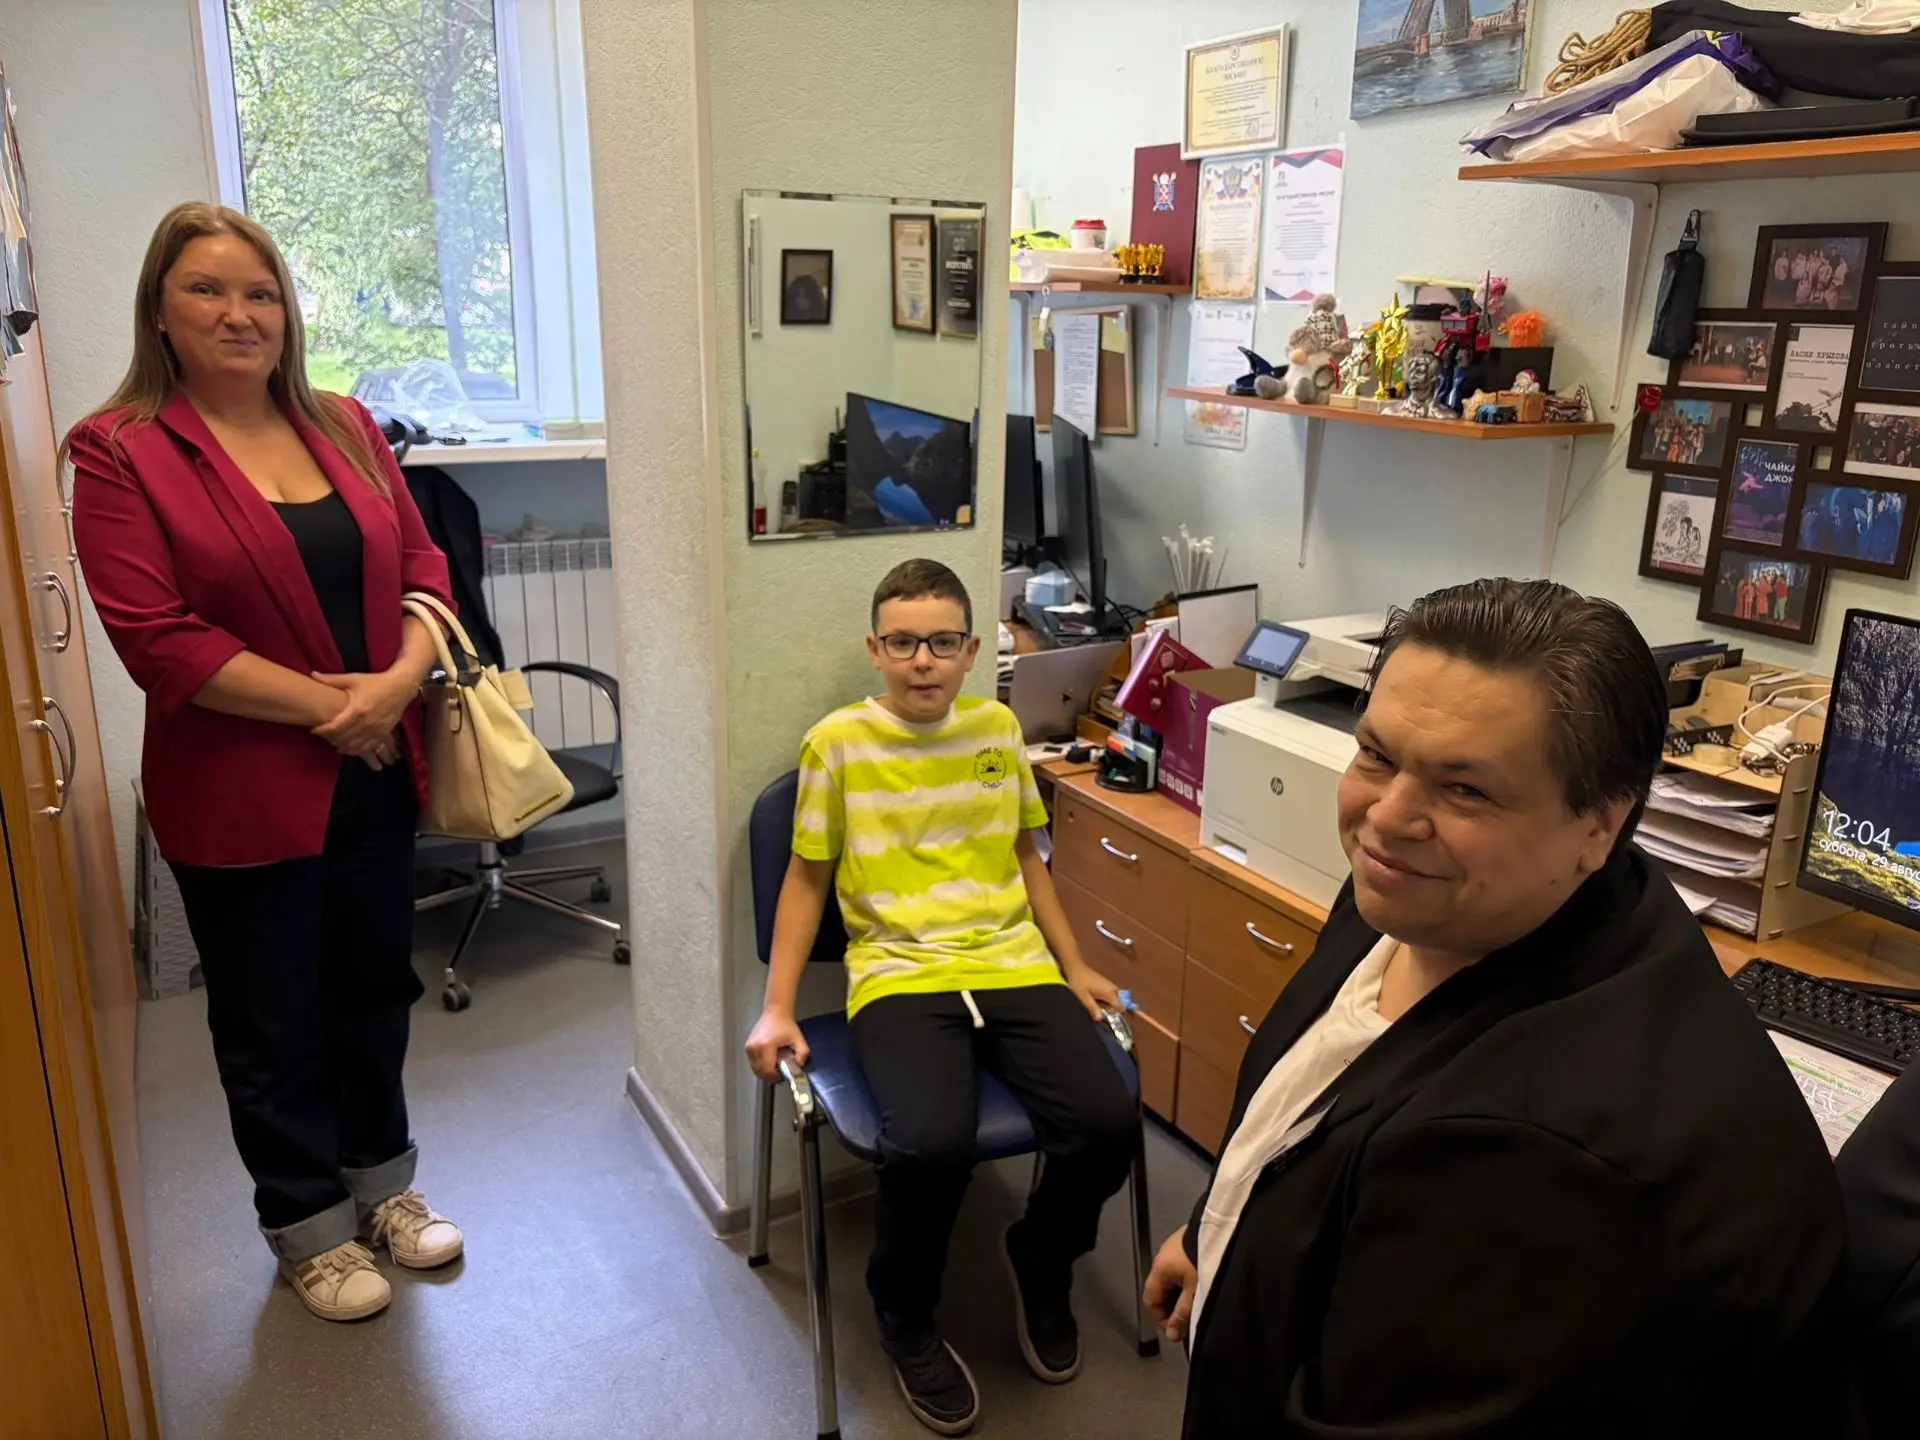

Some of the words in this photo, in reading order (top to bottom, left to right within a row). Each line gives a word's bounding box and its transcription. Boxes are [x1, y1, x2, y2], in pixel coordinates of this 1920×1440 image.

[1270, 776, 1284, 796] hp
[1823, 809, 1891, 850] 12:04
[1818, 838, 1868, 864] суббота,
[1871, 853, 1888, 867] 29
